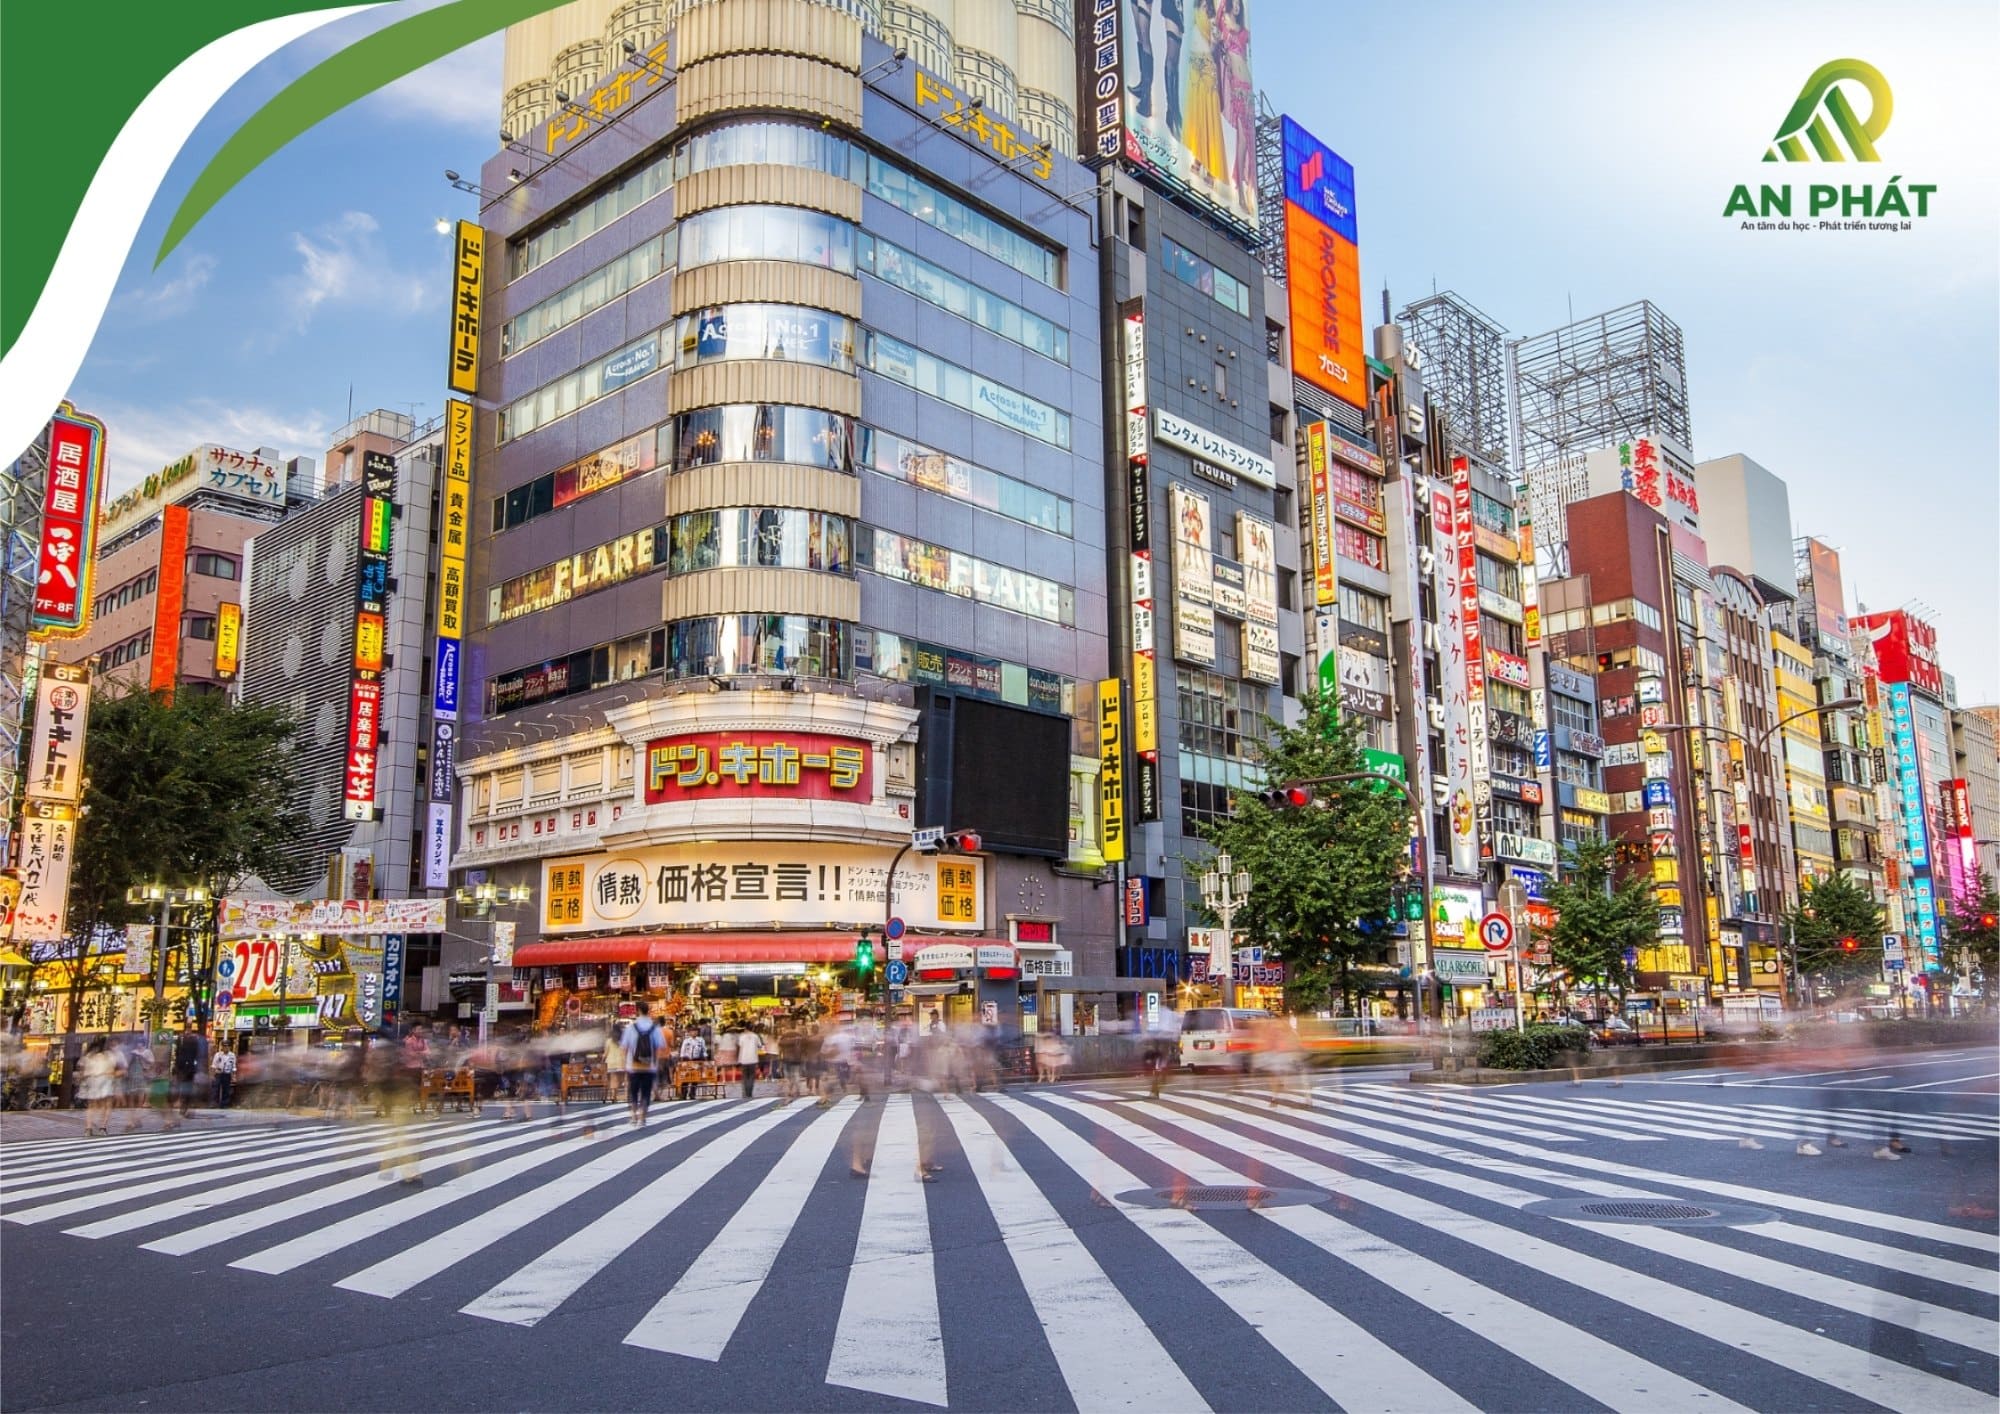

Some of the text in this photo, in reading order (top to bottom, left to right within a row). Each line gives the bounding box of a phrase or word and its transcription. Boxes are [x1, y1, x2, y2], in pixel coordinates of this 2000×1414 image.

[1319, 228, 1339, 354] PROMISE
[1318, 354, 1348, 383] プロミス
[451, 406, 468, 477] ブランド品
[1161, 418, 1273, 476] エンタメ レストランタワー
[52, 440, 82, 514] 居酒屋
[210, 467, 285, 499] カプセル
[448, 492, 463, 546] 貴金属
[553, 528, 652, 597] FLARE
[443, 566, 460, 630] 高額買取
[949, 553, 1059, 617] FLARE
[500, 603, 532, 621] PHOTO
[55, 665, 81, 681] 6F
[917, 652, 944, 674] 販売
[948, 662, 972, 675] ブランド
[1536, 732, 1545, 765] 747
[39, 806, 66, 818] 5F
[551, 870, 582, 892] 情熱
[598, 868, 641, 905] 情熱
[656, 862, 842, 904] 価格宣言!!
[941, 867, 973, 889] 情熱
[550, 898, 580, 920] 価格
[941, 895, 973, 917] 価格
[1129, 890, 1141, 925] ダイコク
[1885, 937, 1896, 949] P
[233, 939, 279, 1000] 270
[313, 959, 342, 972] カラオケ
[384, 938, 400, 997] カラオケ
[1024, 960, 1071, 975] 価格宣言!!
[315, 993, 347, 1018] 747
[363, 972, 377, 1022] カラオケ
[1150, 995, 1156, 1005] P
